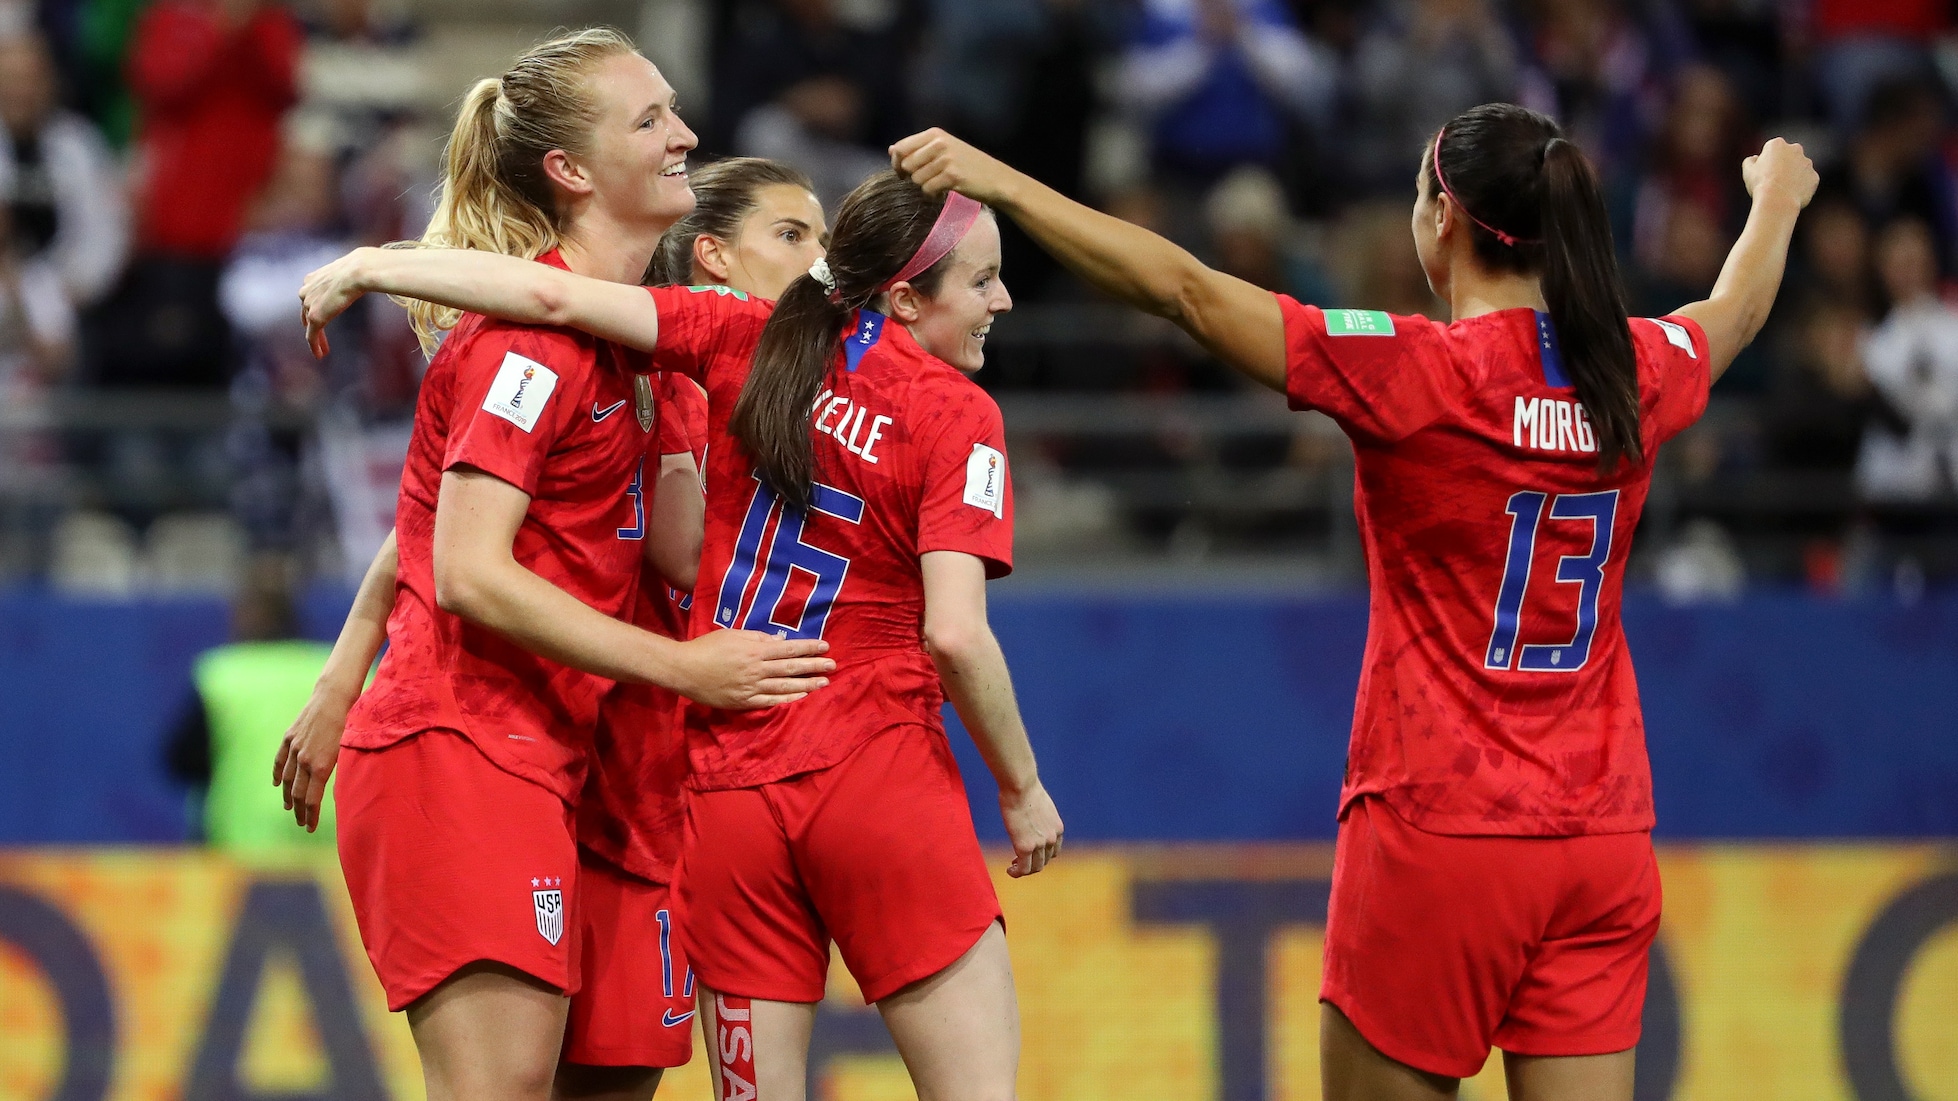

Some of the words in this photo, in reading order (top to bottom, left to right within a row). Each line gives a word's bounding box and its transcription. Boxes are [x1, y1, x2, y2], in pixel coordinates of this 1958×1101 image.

[493, 403, 516, 418] FRANCE
[806, 382, 893, 464] VELLE
[1513, 396, 1602, 452] MORG
[713, 470, 865, 640] 16
[1484, 489, 1620, 672] 13
[536, 894, 561, 914] USA
[717, 993, 757, 1101] USA
